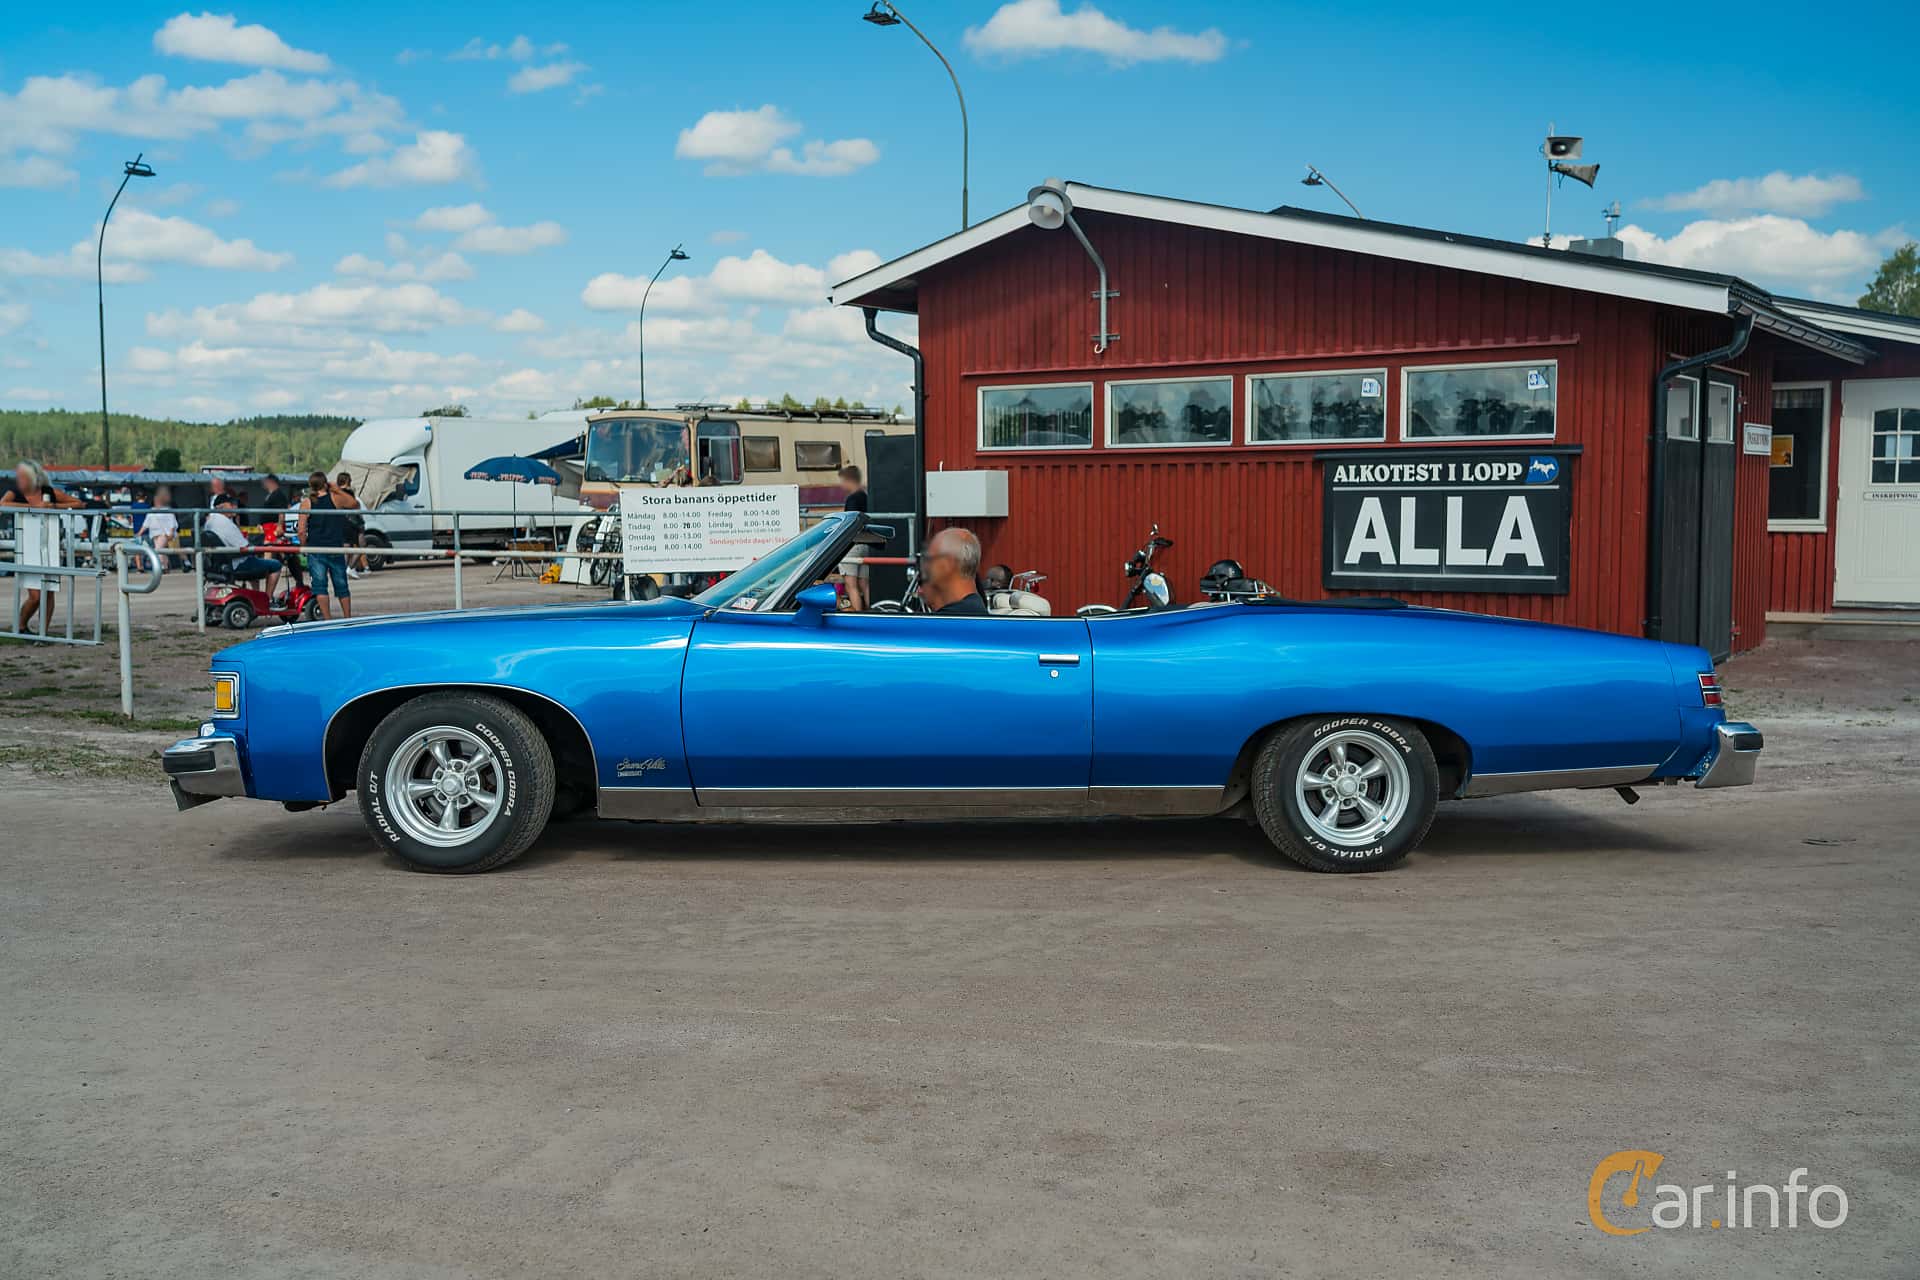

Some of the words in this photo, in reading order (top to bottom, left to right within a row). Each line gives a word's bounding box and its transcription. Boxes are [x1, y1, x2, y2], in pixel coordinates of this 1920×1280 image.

[1333, 463, 1442, 483] ALKOTEST
[1447, 463, 1456, 482] I
[1462, 462, 1523, 482] LOPP
[642, 495, 672, 505] Stora
[674, 494, 715, 505] banans
[717, 492, 777, 505] öppettider
[627, 512, 655, 520] Måndag
[708, 510, 733, 518] Fredag
[1344, 495, 1545, 567] ALLA
[629, 544, 657, 552] Torsdag
[1313, 717, 1369, 738] COOPER
[1372, 720, 1413, 754] COBRA
[475, 722, 513, 768] COOPER
[504, 770, 517, 817] COBRA
[370, 797, 401, 843] RADIAL
[1330, 844, 1384, 859] RADIAL
